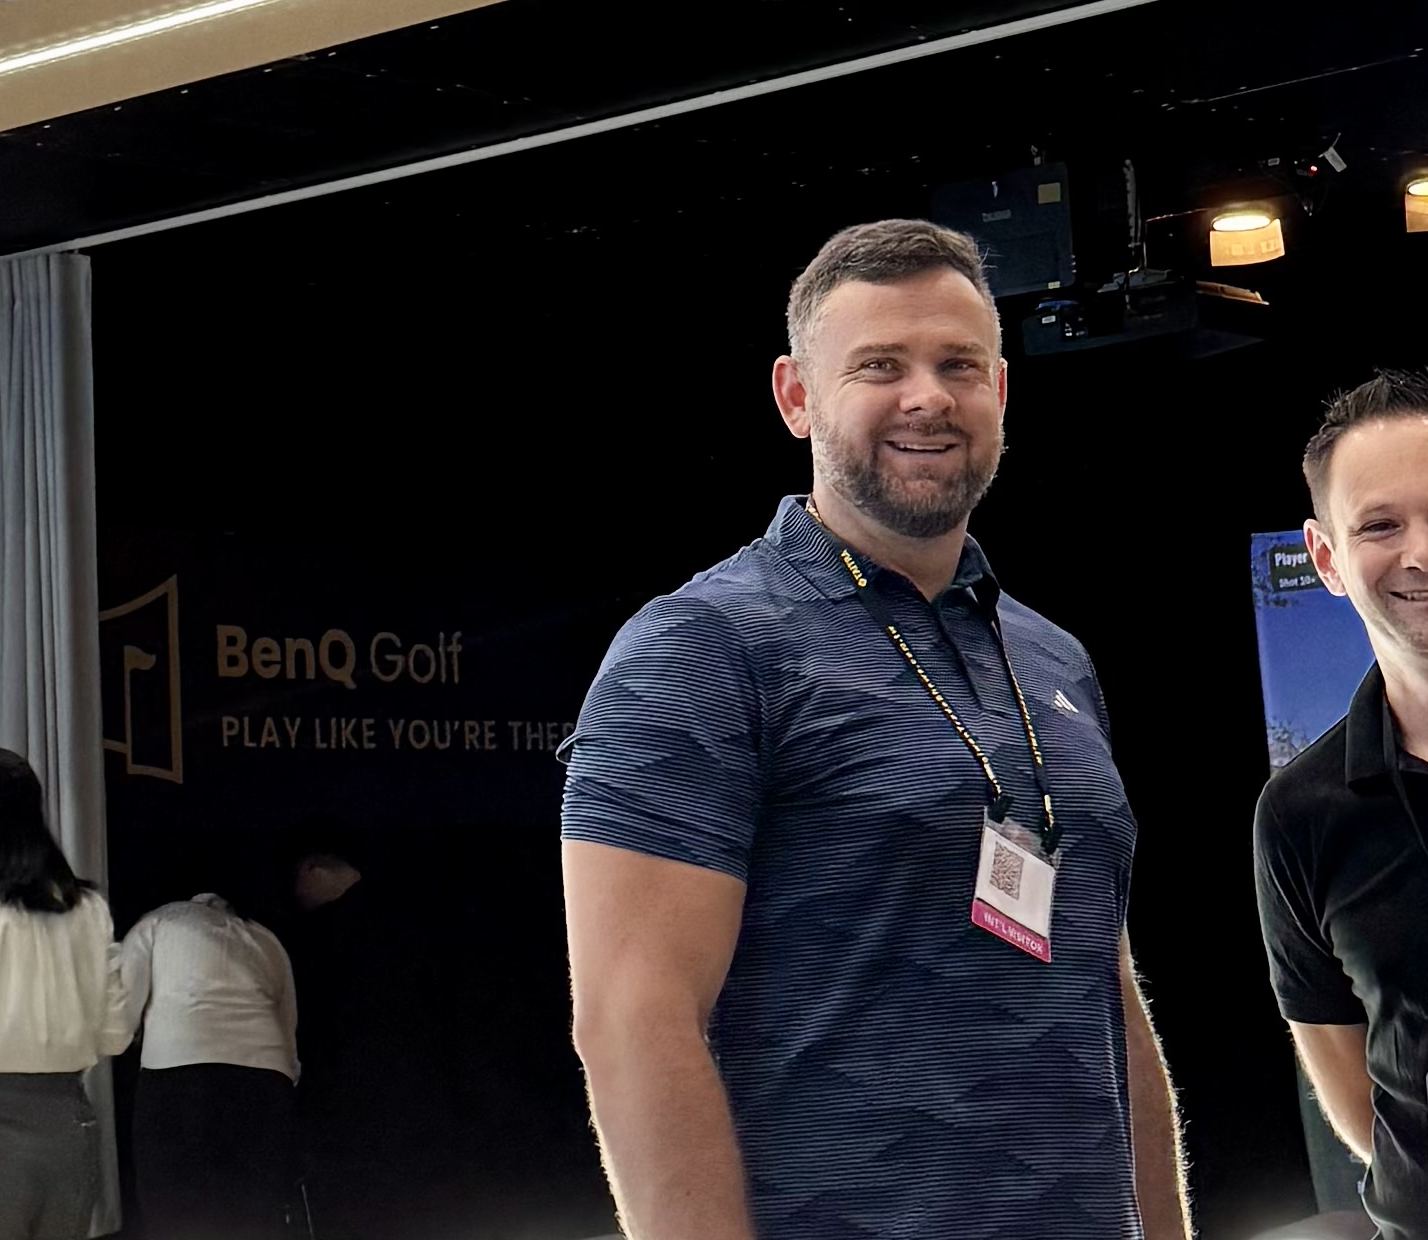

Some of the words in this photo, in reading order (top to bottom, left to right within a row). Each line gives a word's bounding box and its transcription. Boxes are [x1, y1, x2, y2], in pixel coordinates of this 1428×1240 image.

[1275, 553, 1308, 567] Player
[217, 624, 357, 689] BenQ
[370, 631, 463, 684] Golf
[221, 716, 301, 749] PLAY
[315, 717, 376, 749] LIKE
[389, 719, 497, 751] YOU'RE
